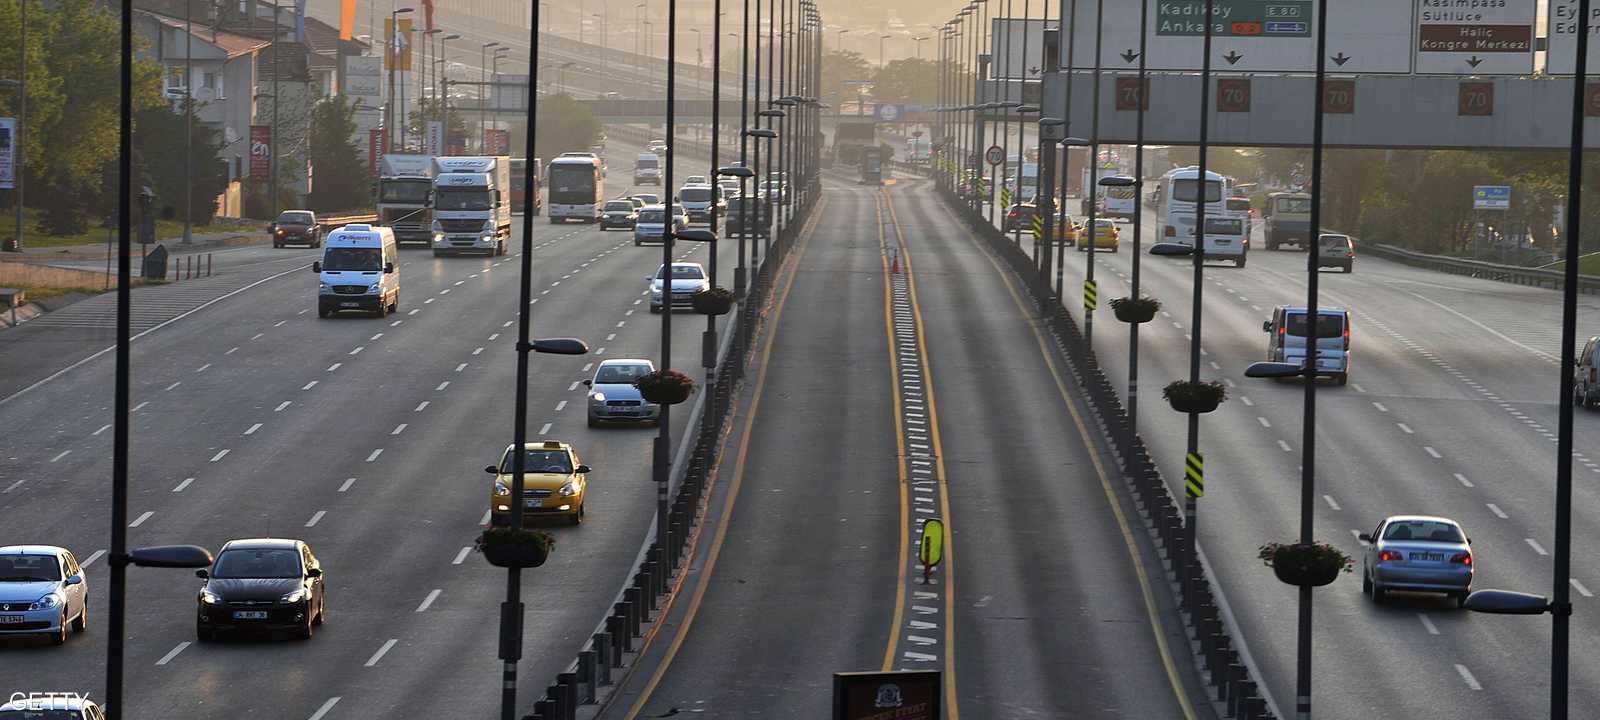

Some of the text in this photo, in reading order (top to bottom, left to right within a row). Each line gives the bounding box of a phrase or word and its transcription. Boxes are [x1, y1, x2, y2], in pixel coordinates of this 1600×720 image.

[1280, 7, 1297, 15] 80
[1557, 5, 1600, 20] Eyp
[1160, 20, 1224, 32] Ankaa
[1421, 40, 1529, 50] Kongre Merkezi
[1225, 88, 1243, 104] 70
[1329, 90, 1347, 105] 70
[1466, 92, 1487, 107] 70
[990, 151, 1001, 161] 70
